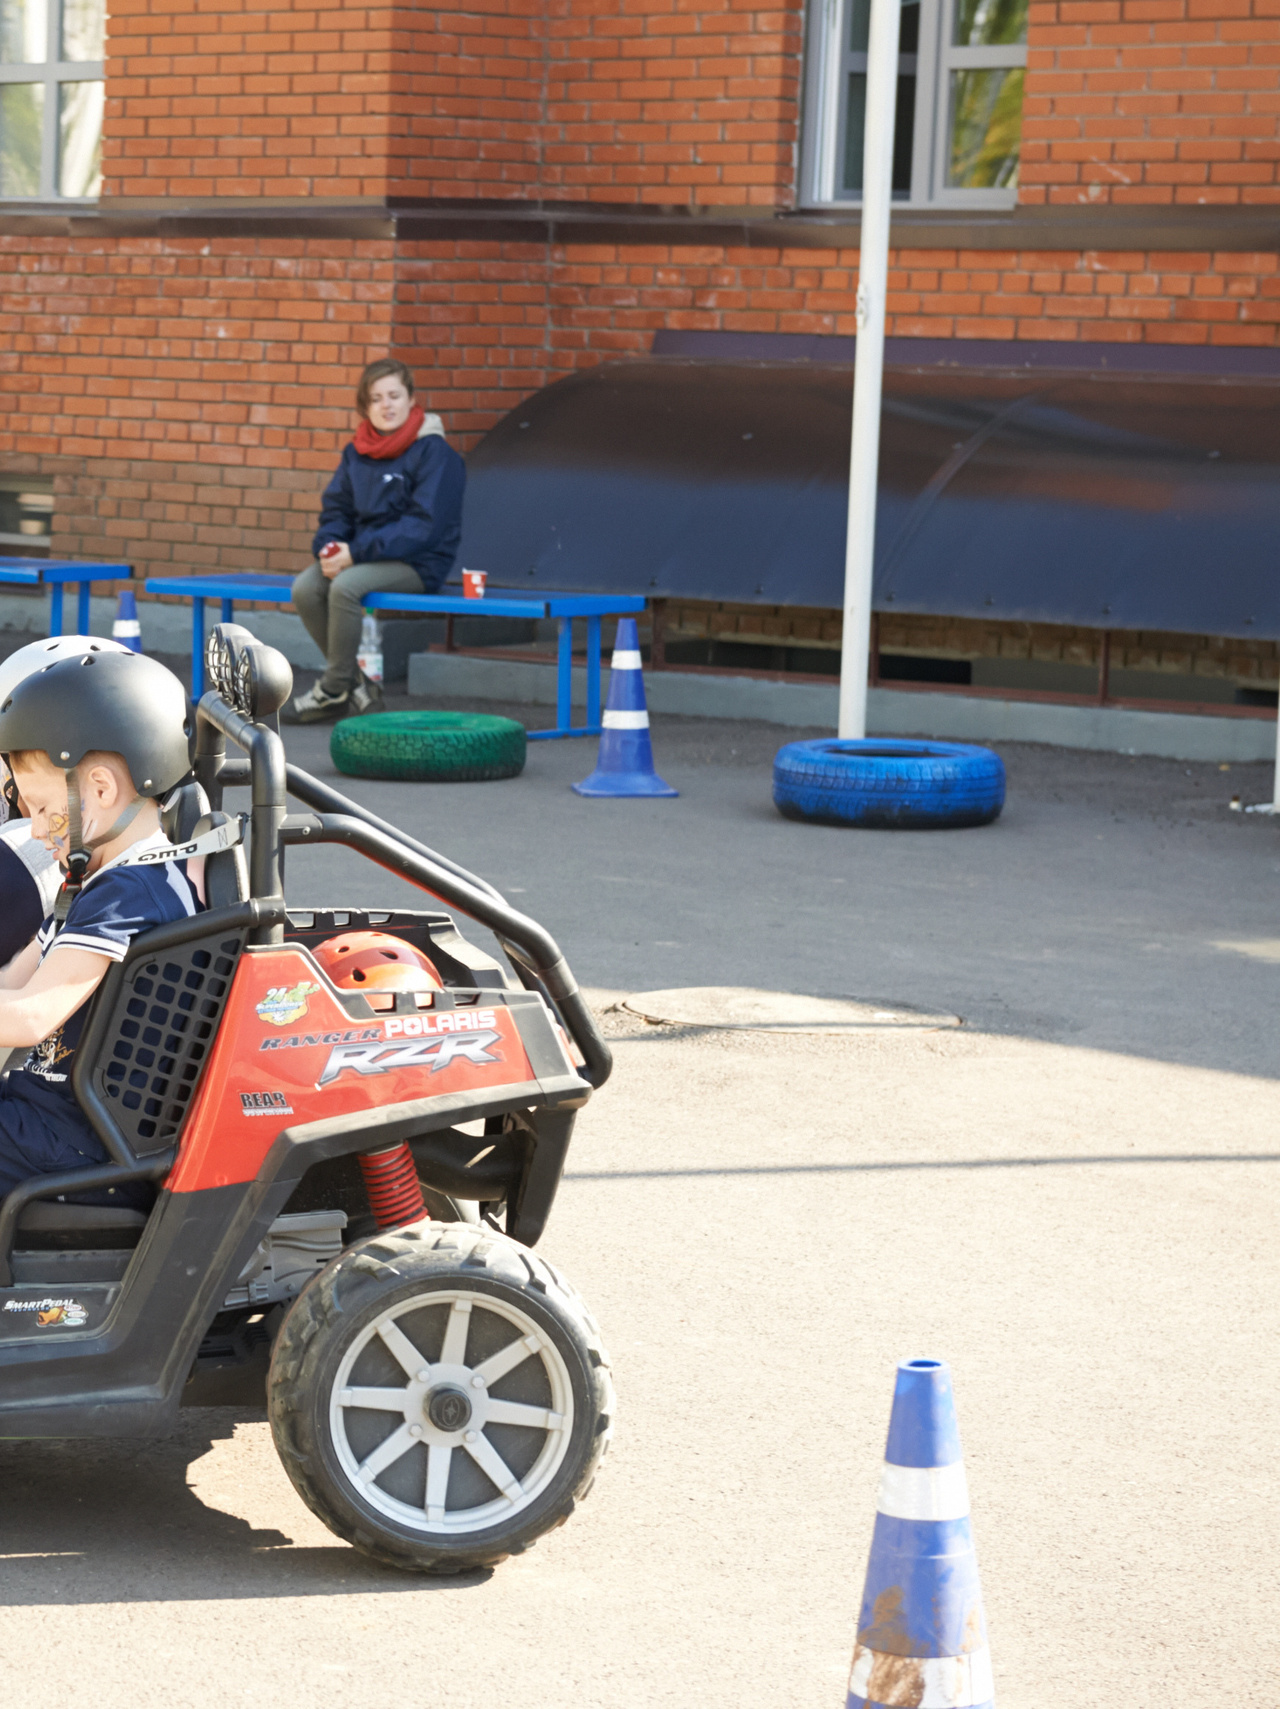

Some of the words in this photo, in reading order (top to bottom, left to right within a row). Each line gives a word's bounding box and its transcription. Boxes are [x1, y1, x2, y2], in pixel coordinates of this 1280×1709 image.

[384, 1010, 497, 1037] POLARIS
[259, 1027, 382, 1051] RANGER
[316, 1030, 506, 1088] RZR
[239, 1091, 287, 1107] REAR
